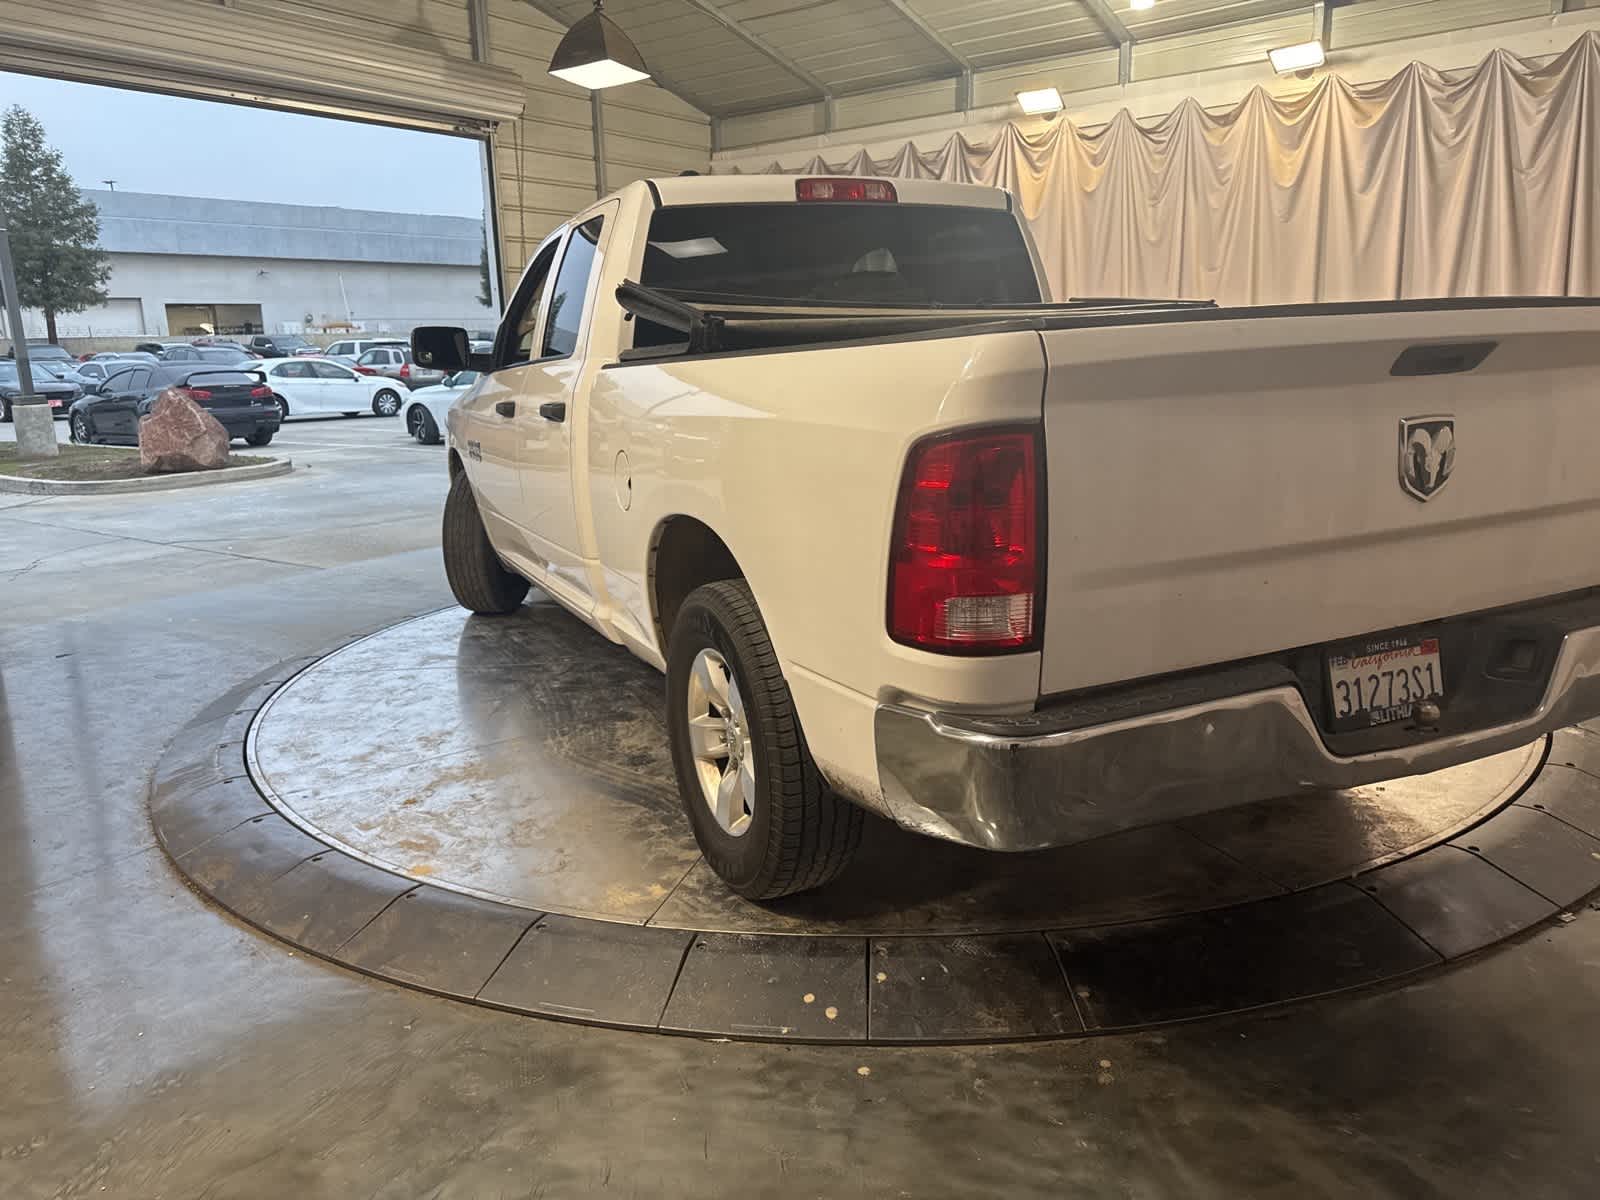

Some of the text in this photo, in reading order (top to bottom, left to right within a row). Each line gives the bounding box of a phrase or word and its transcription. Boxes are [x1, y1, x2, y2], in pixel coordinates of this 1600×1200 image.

[1351, 647, 1421, 670] California
[1366, 641, 1389, 653] SINCE
[1335, 662, 1437, 718] 31273S1
